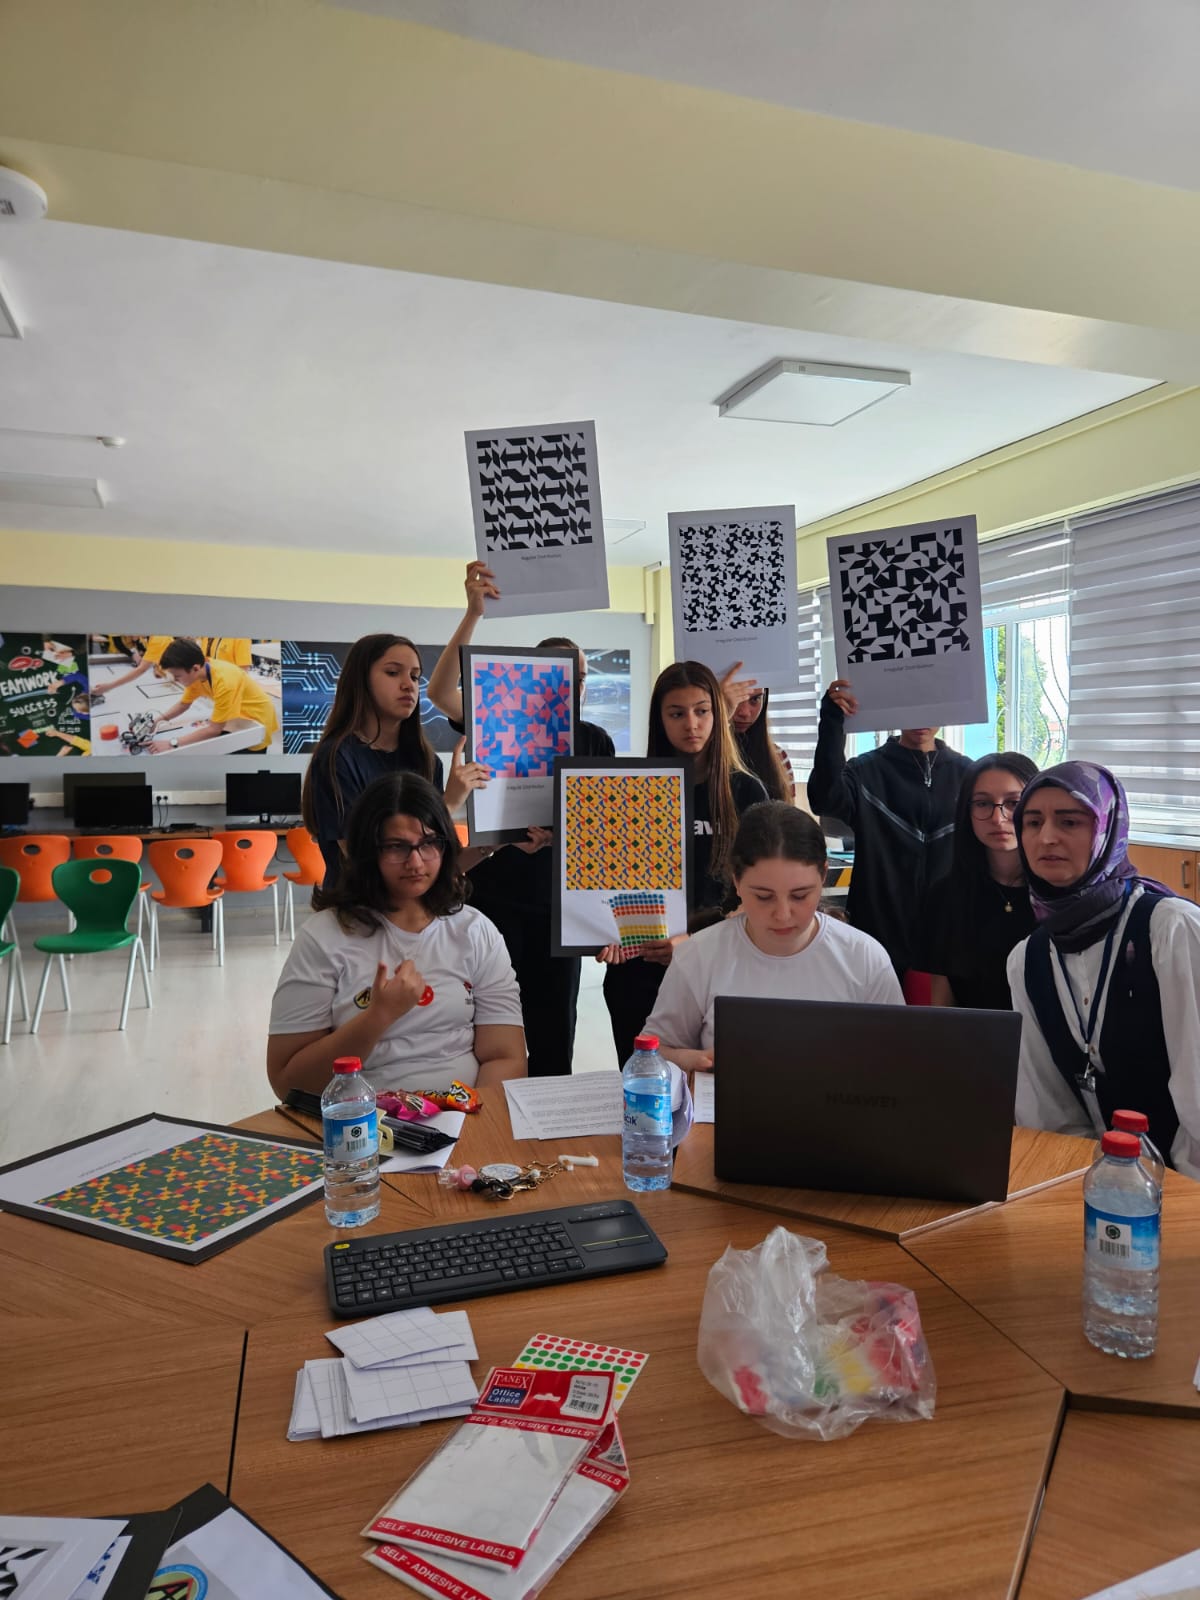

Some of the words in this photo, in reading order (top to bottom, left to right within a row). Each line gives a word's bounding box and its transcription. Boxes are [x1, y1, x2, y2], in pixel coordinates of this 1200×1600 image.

[0, 670, 58, 697] EAMWORK
[9, 698, 58, 718] SUCCESS
[825, 1092, 897, 1109] HUAWEI
[494, 1373, 530, 1389] TANEX
[487, 1394, 520, 1405] Labels
[491, 1387, 521, 1398] Office
[581, 1465, 621, 1486] LABELS
[376, 1520, 407, 1532] SELF
[412, 1528, 470, 1548] ADHESIVE
[469, 1542, 516, 1560] LABELS
[380, 1545, 408, 1564] SELF
[411, 1562, 463, 1596] ADHESIVE
